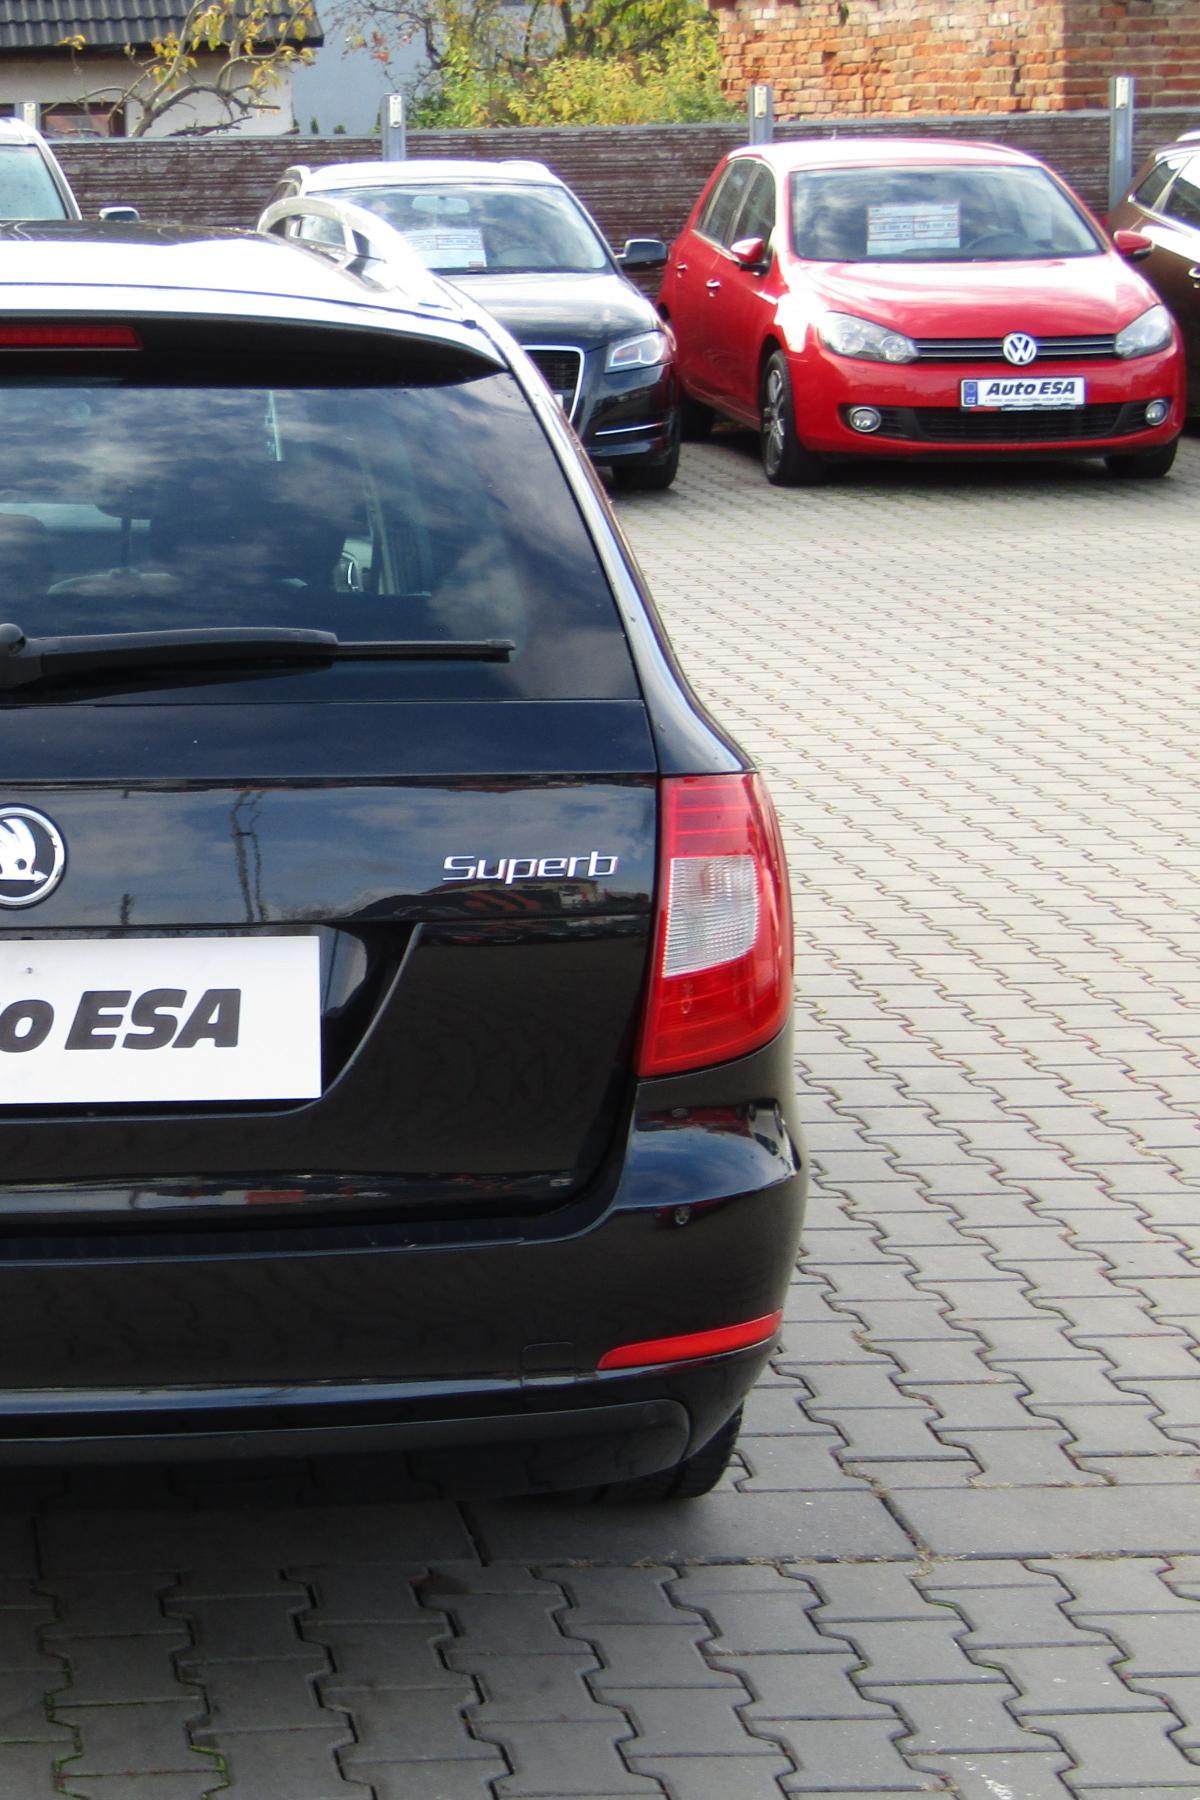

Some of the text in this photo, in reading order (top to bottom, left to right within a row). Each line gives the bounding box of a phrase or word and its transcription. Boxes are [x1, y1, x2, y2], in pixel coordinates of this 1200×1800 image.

[986, 381, 1076, 396] Auto ESA
[443, 851, 619, 885] Superb
[64, 987, 242, 1051] ESA
